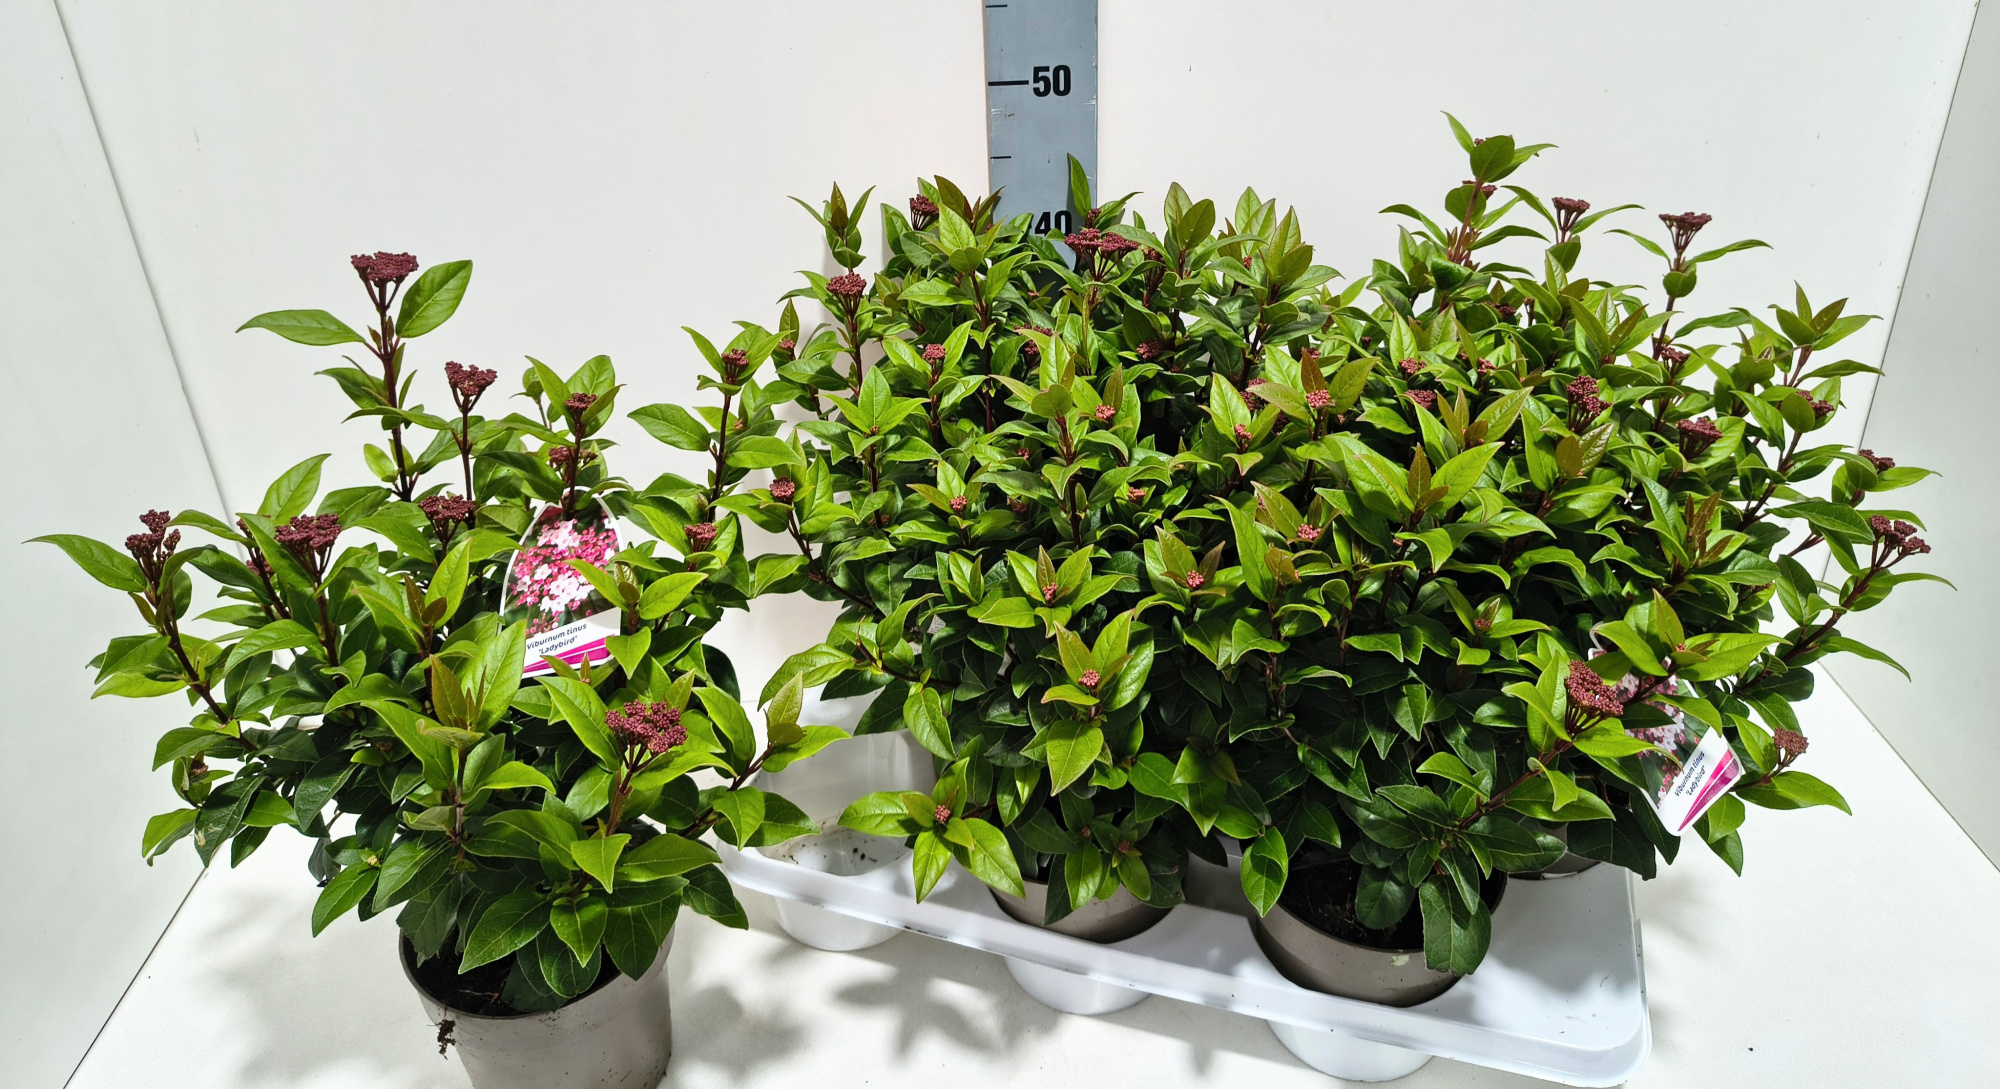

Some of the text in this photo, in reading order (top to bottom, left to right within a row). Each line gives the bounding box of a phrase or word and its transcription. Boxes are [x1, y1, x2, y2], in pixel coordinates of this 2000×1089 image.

[1033, 65, 1071, 97] 50
[1034, 210, 1072, 237] 40
[526, 623, 587, 650] Viburnum tinus
[1674, 750, 1705, 797] Viburnum tinus
